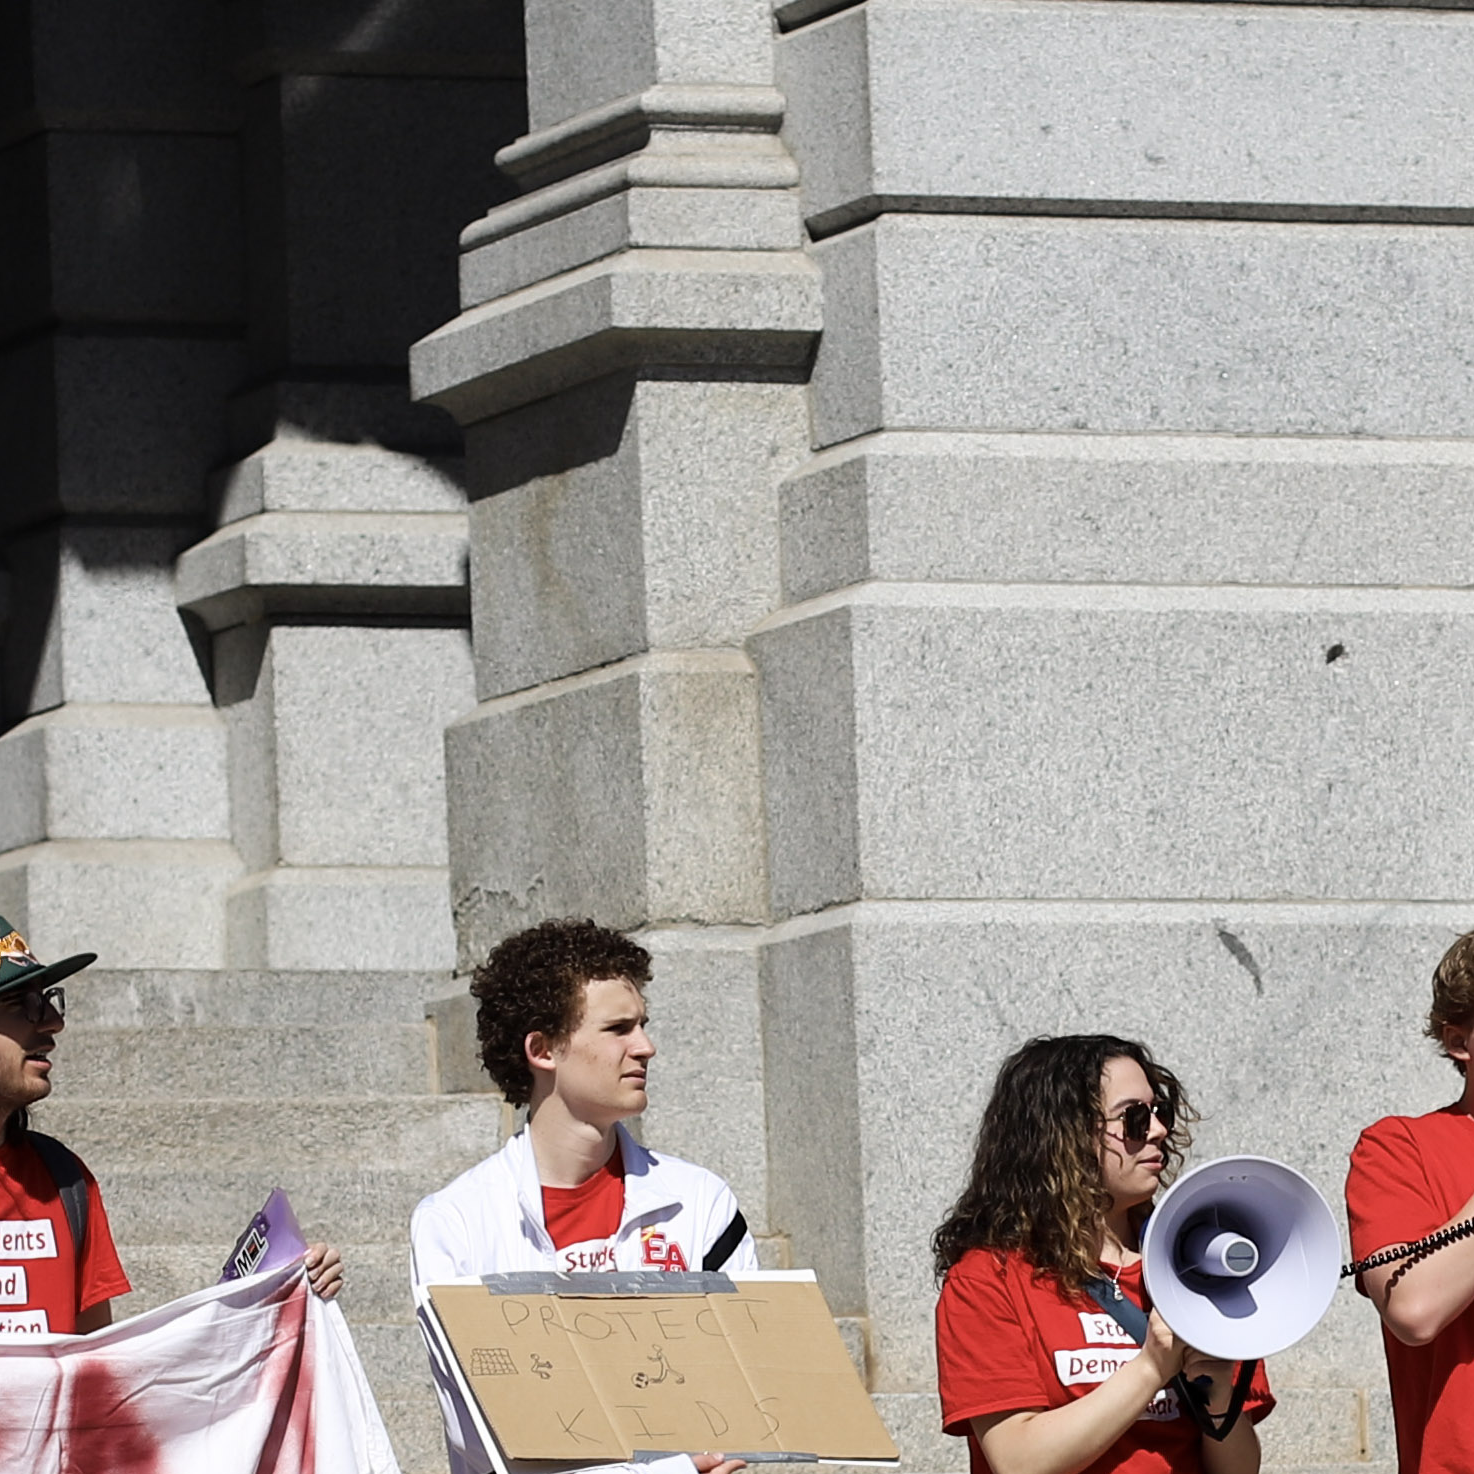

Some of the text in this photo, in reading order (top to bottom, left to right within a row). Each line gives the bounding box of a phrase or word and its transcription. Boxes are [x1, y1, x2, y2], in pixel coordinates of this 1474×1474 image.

[501, 1299, 769, 1342] PROTECT
[1069, 1356, 1126, 1377] Dem
[556, 1396, 780, 1444] KIDS
